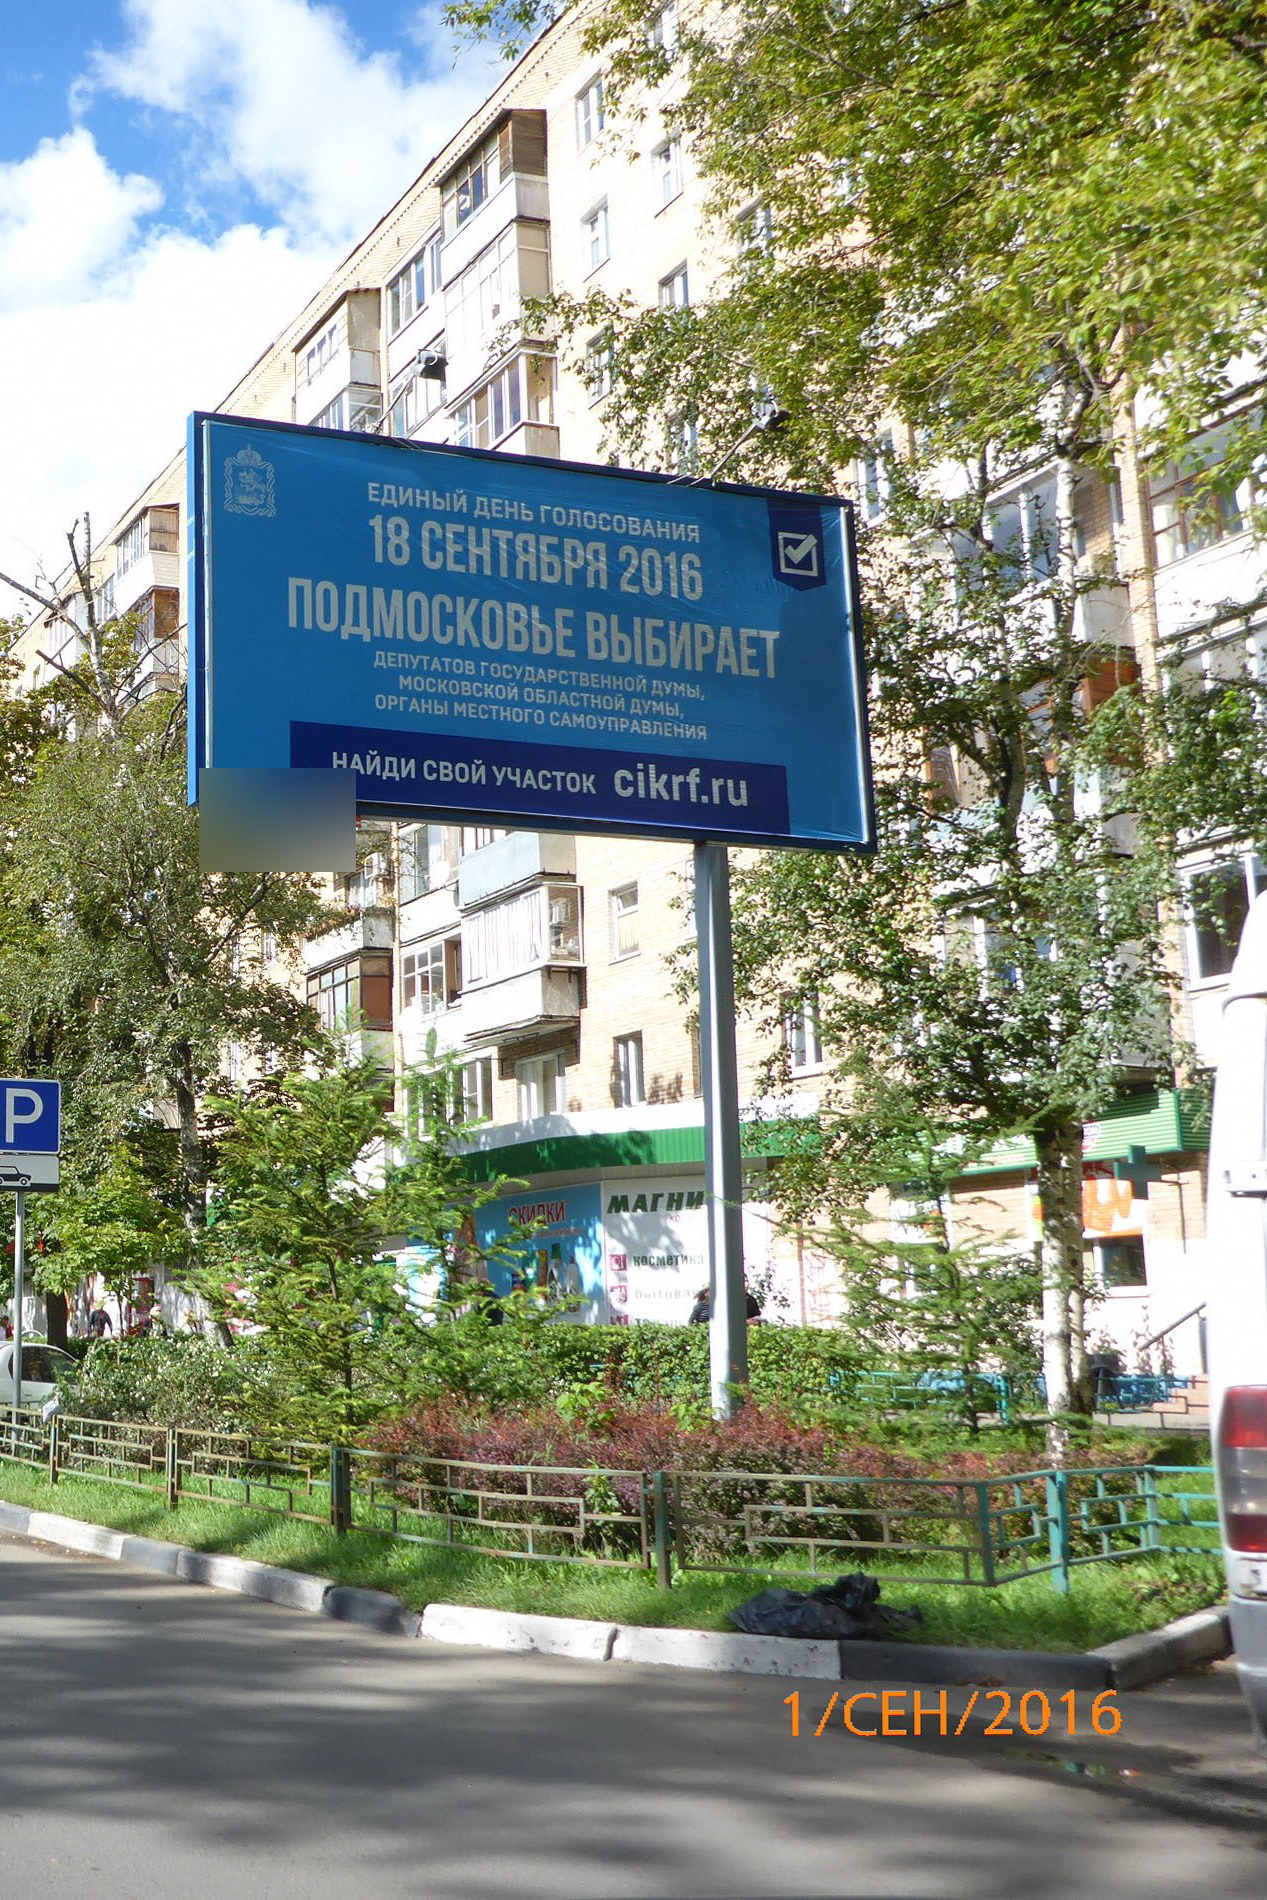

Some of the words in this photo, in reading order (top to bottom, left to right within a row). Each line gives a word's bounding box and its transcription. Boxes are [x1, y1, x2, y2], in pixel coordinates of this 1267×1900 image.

[367, 481, 468, 514] ЕДИНЫЙ
[473, 495, 534, 522] ДЕНЬ
[539, 504, 701, 544] ГОЛОСОВАНИЯ
[368, 513, 411, 567] 18
[420, 519, 609, 591] СЕНТЯБРЯ
[617, 544, 704, 601] 2016
[287, 576, 577, 659] ПОДМОСКОВЬЕ
[585, 610, 781, 679] ВЫБИРАЕТ
[373, 650, 476, 676] ДЕПУТАТОВ
[480, 661, 647, 694] ГОСУДАРСТВЕННОЙ
[651, 680, 706, 702] ДУМЫ,
[398, 674, 519, 702] МОСКОВСКОЙ
[523, 686, 626, 713] ОБЛАСТНОЙ
[629, 698, 684, 719] ДУМЫ,
[374, 693, 449, 716] ОРГАНЫ
[453, 701, 545, 726] МЕСТНОГО
[549, 711, 708, 741] САМОУПРАВЛЕНИЯ
[331, 750, 416, 781] НАЙДИ
[422, 759, 487, 785] СВОЙ
[491, 765, 597, 795] УЧАСТОК
[613, 762, 749, 807] cikrf.ru
[4, 1086, 44, 1144] P
[508, 1200, 566, 1226] СКИДКИ
[633, 1253, 705, 1267] косметика
